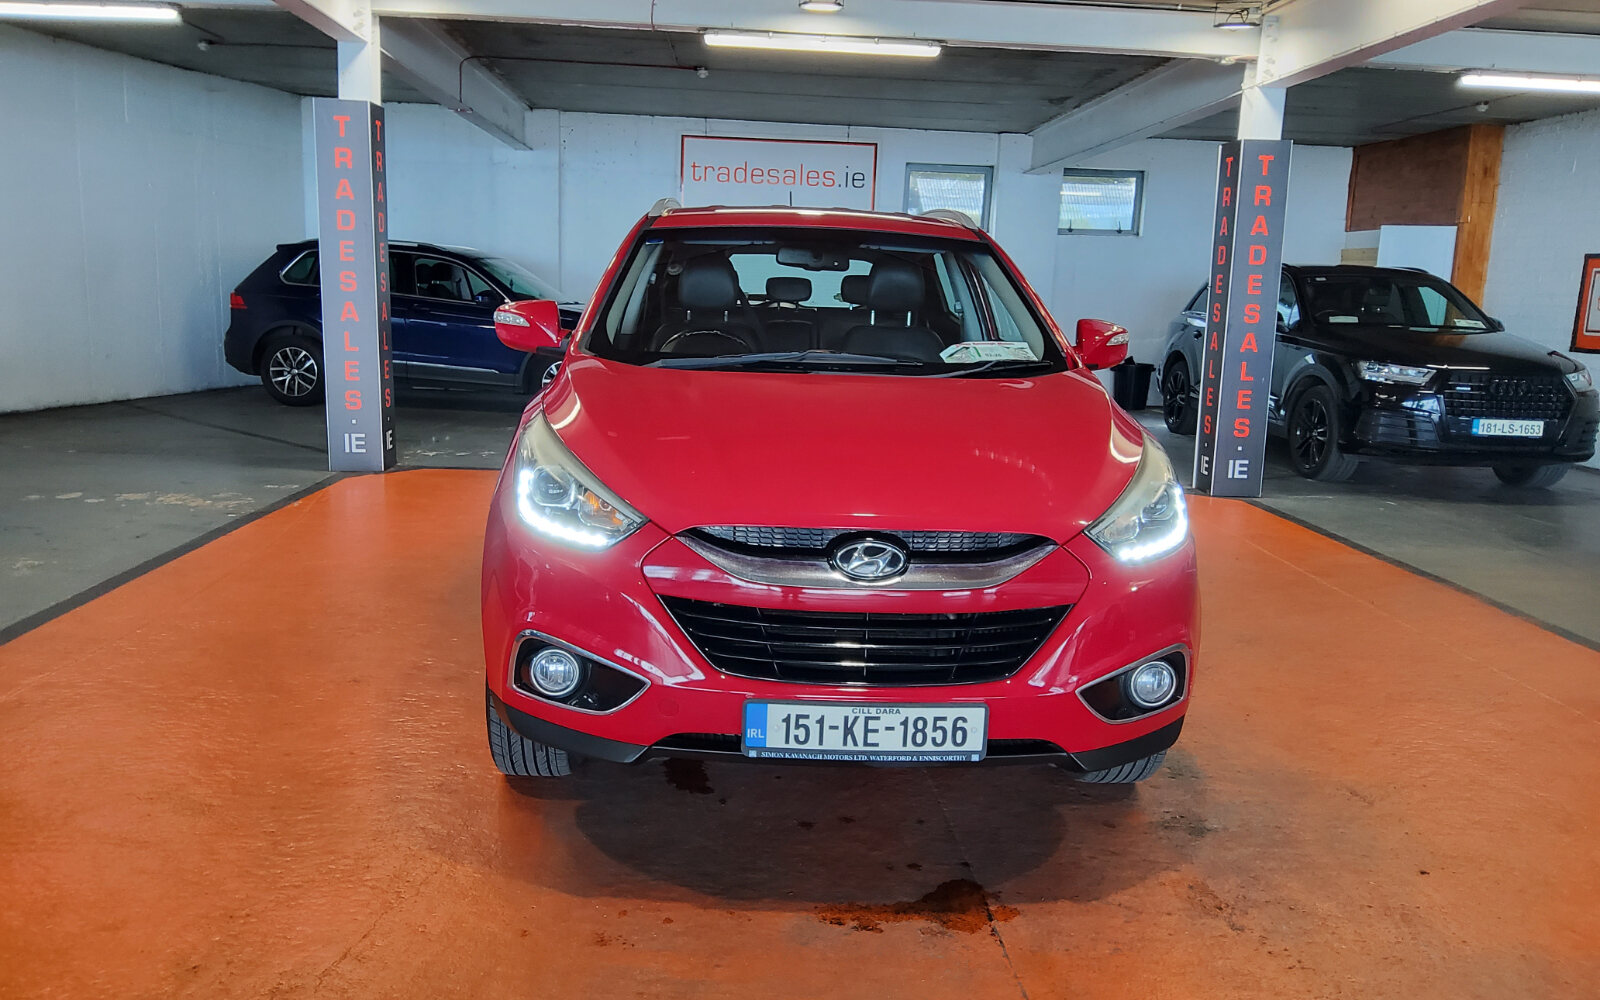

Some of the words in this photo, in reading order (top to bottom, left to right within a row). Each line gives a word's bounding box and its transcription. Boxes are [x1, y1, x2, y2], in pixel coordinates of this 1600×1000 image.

[690, 160, 866, 189] tradesales.ie
[1480, 422, 1542, 435] 181-LS-1653
[746, 728, 765, 739] IRL
[781, 713, 969, 748] 151-KE-1856
